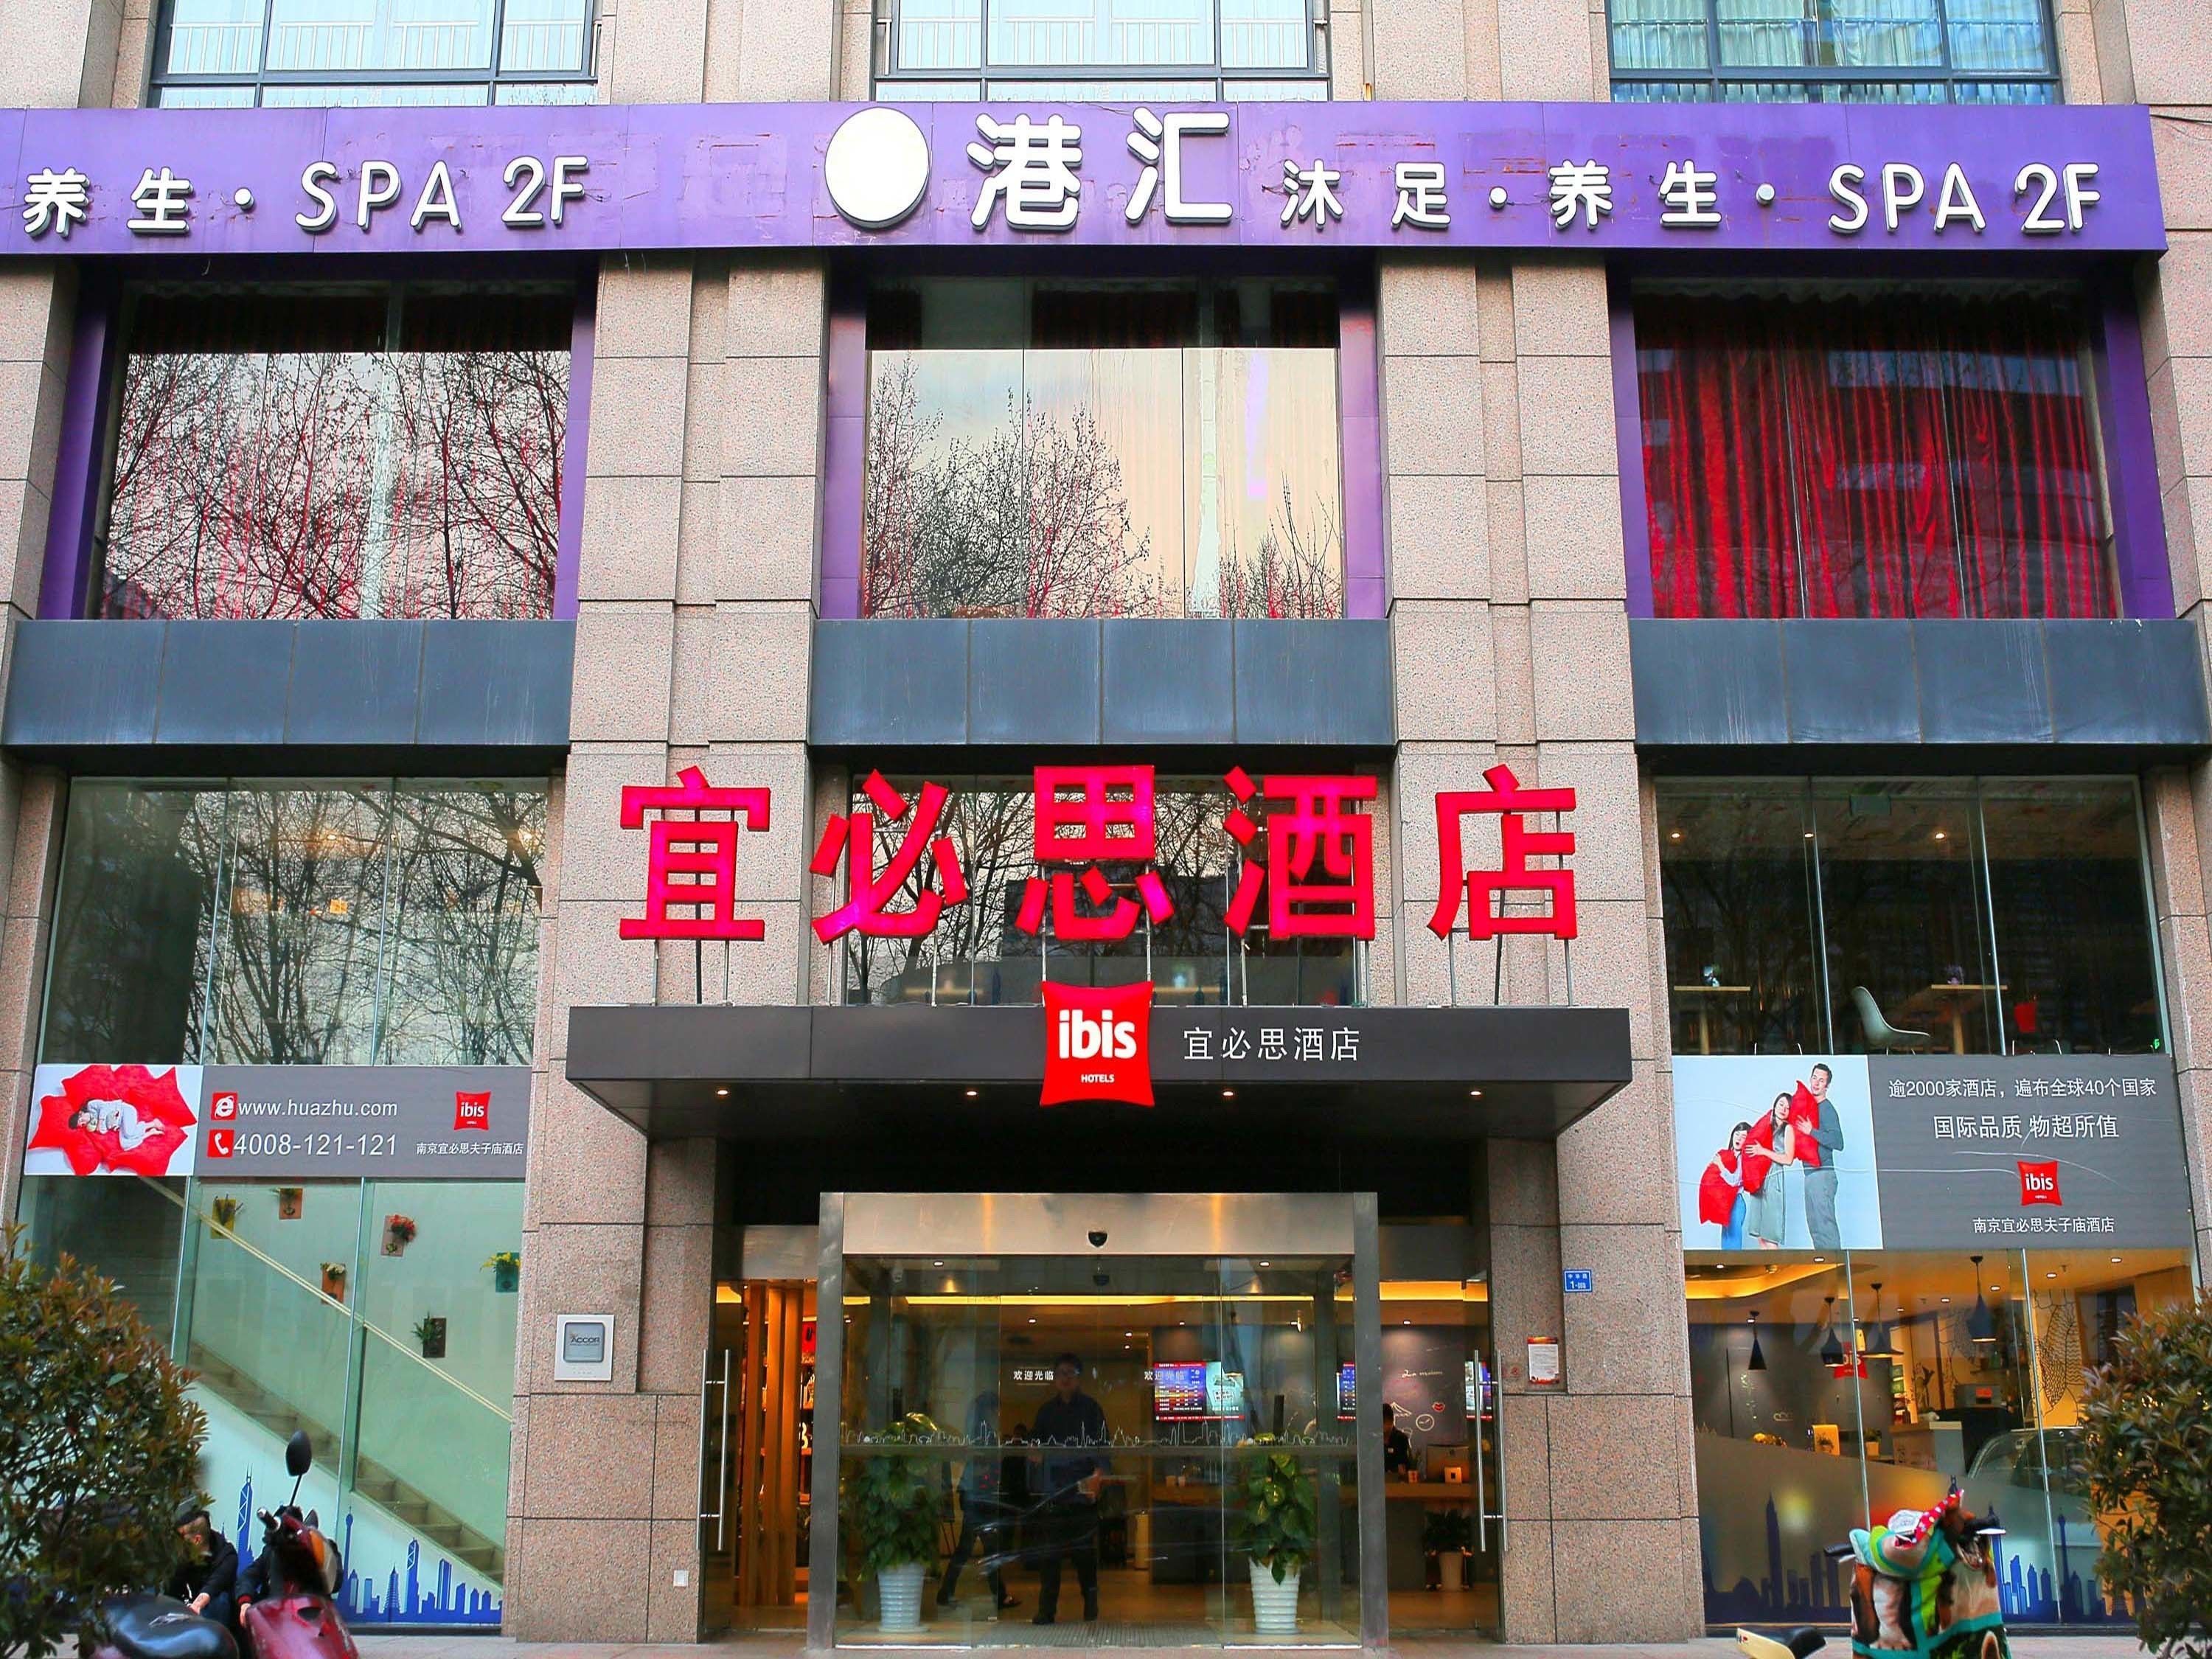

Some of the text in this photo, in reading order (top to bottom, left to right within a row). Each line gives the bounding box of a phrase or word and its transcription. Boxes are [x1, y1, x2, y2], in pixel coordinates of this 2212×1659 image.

[966, 105, 1234, 230] 港汇
[295, 161, 463, 234] SPA
[501, 156, 591, 228] 2F
[1828, 162, 1988, 234] SPA
[2014, 162, 2101, 235] 2F
[619, 763, 1578, 943] 宜必思酒店
[1059, 1009, 1137, 1060] ibis
[1183, 1026, 1360, 1062] 宜必思酒店
[1080, 1074, 1115, 1083] HOTELS
[237, 1099, 398, 1116] www.huazhu.com
[459, 1102, 485, 1118] ibis
[1933, 1113, 2121, 1140] 国际品质 物超所值
[233, 1133, 397, 1156] 4008-121-121
[415, 1142, 525, 1155] 南京宜必思夫子庙酒店
[2025, 1172, 2055, 1192] ibis
[1972, 1216, 2115, 1234] 南京宜必思夫子庙酒店
[1013, 1369, 1054, 1381] 欢迎光临
